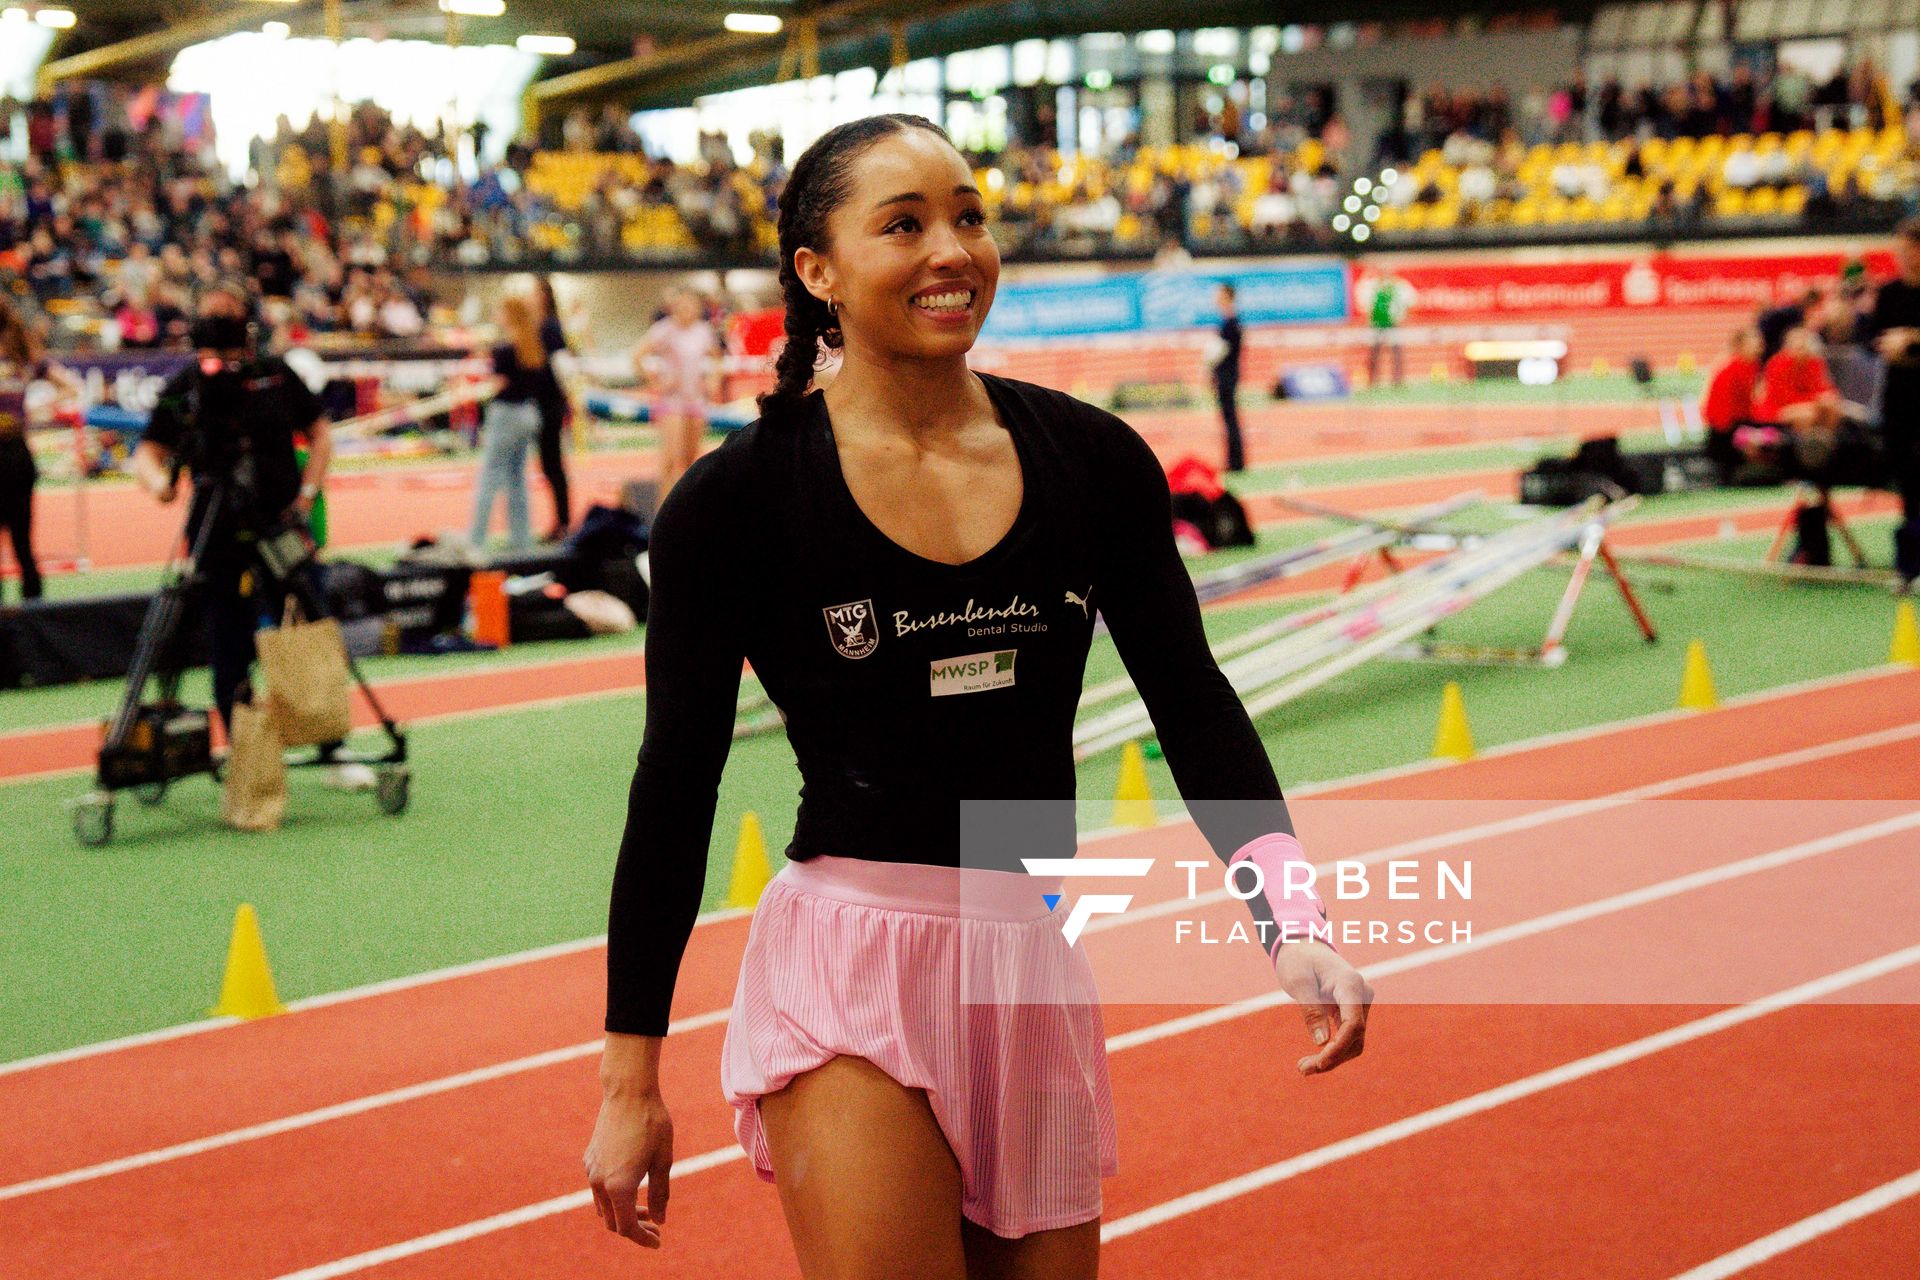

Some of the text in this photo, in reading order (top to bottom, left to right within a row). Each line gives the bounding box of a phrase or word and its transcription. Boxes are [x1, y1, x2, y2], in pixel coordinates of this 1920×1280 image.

[829, 604, 867, 625] MTG
[893, 595, 1039, 637] Busenbender
[967, 622, 1048, 637] Dental Studio
[838, 638, 876, 656] MANNHEIM
[932, 660, 989, 681] MWSP
